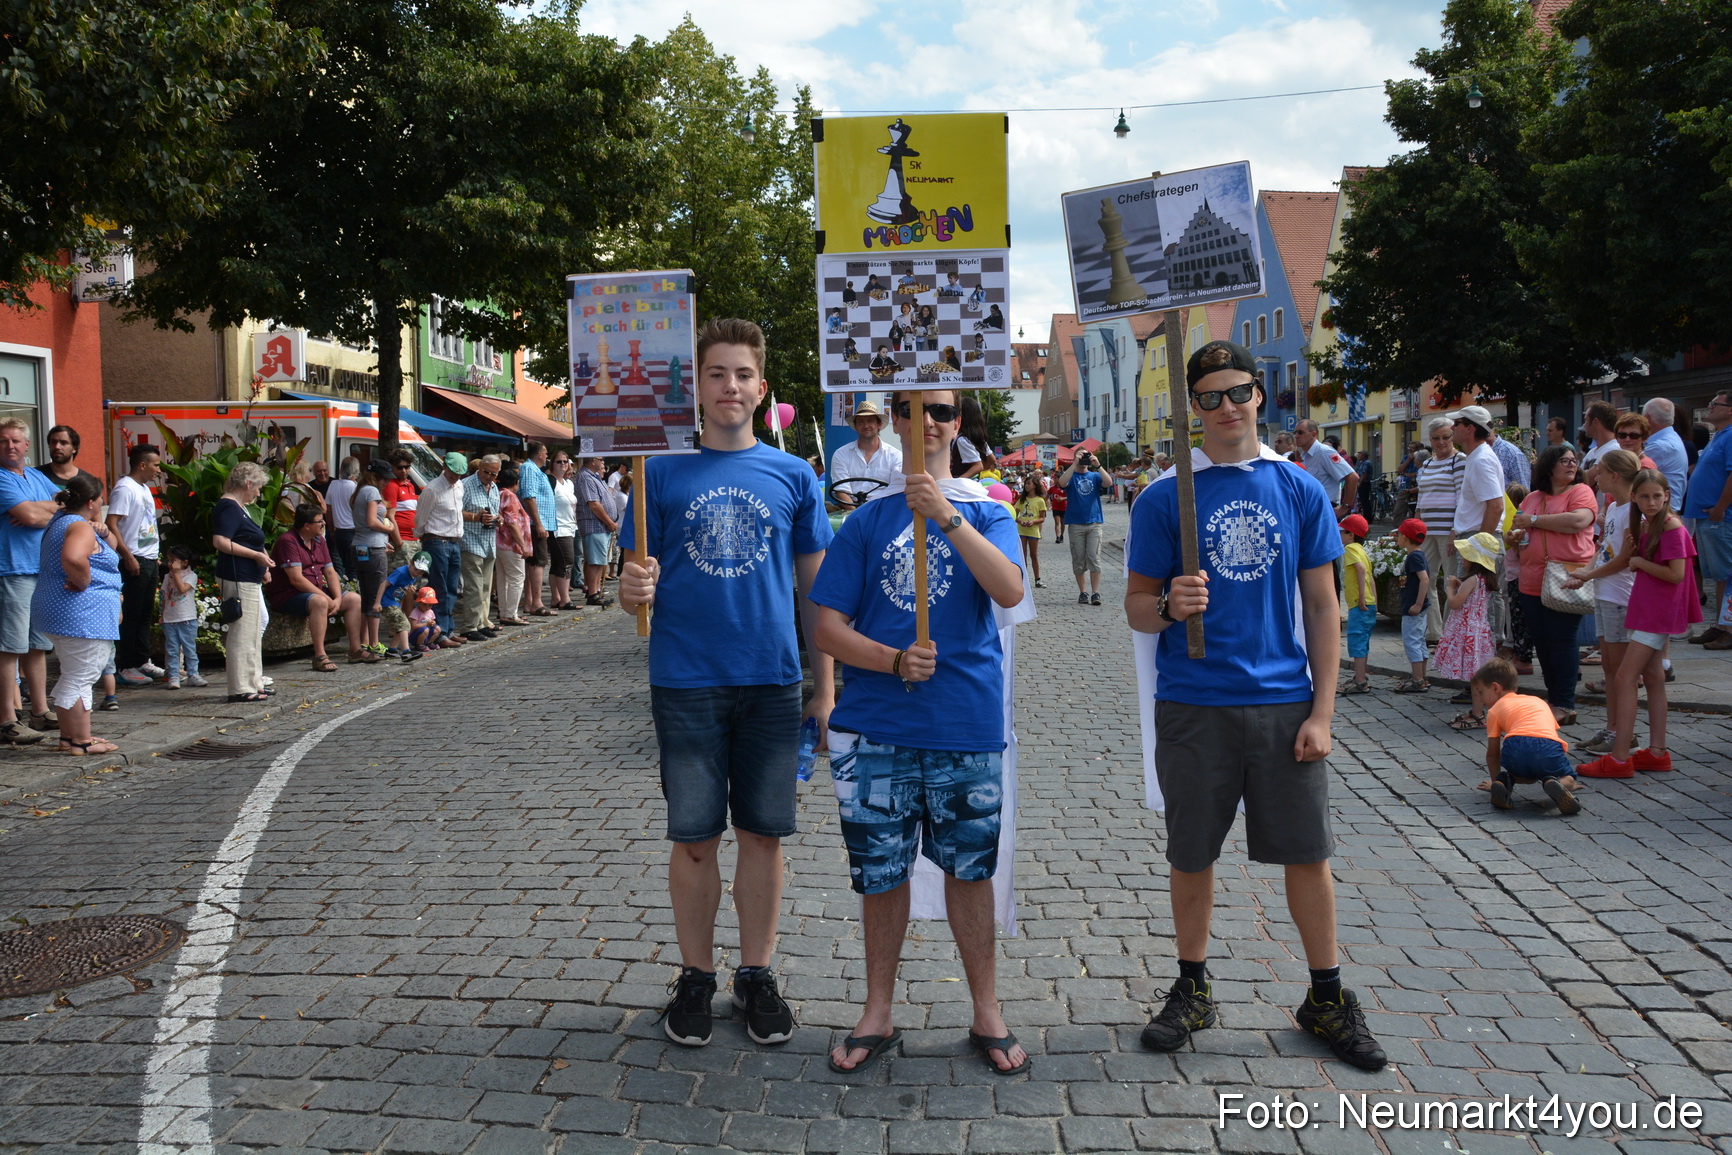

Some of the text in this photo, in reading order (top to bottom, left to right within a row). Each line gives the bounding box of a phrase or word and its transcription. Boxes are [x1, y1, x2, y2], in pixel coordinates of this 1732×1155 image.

[909, 161, 922, 170] SK
[906, 176, 955, 184] NEUMARKT
[1117, 182, 1199, 205] Chefstrategen
[863, 203, 974, 249] MÄDCHEN
[846, 258, 980, 269] Unterstützen Sie Neumarkts klügste Köpfe!
[575, 279, 687, 296] Neumarkt
[1083, 303, 1118, 315] Deutscher
[1119, 292, 1184, 309] TOP-Schachverein
[1188, 290, 1196, 298] in
[1197, 285, 1231, 297] Neumarkt
[1232, 281, 1259, 291] daheim
[574, 298, 688, 318] spielt bunt
[582, 317, 680, 334] Schach für alle
[305, 362, 379, 394] TADT APOTHE
[868, 378, 894, 386] Sponsor
[907, 376, 929, 385] Jugend
[1287, 417, 1295, 430] P
[685, 486, 771, 520] SCHACHKLUB
[1206, 500, 1278, 533] SCHACHKLUB
[684, 540, 755, 578] NEUMARKT
[1207, 550, 1268, 582] NEUMARKT
[880, 578, 937, 613] NEUMAT
